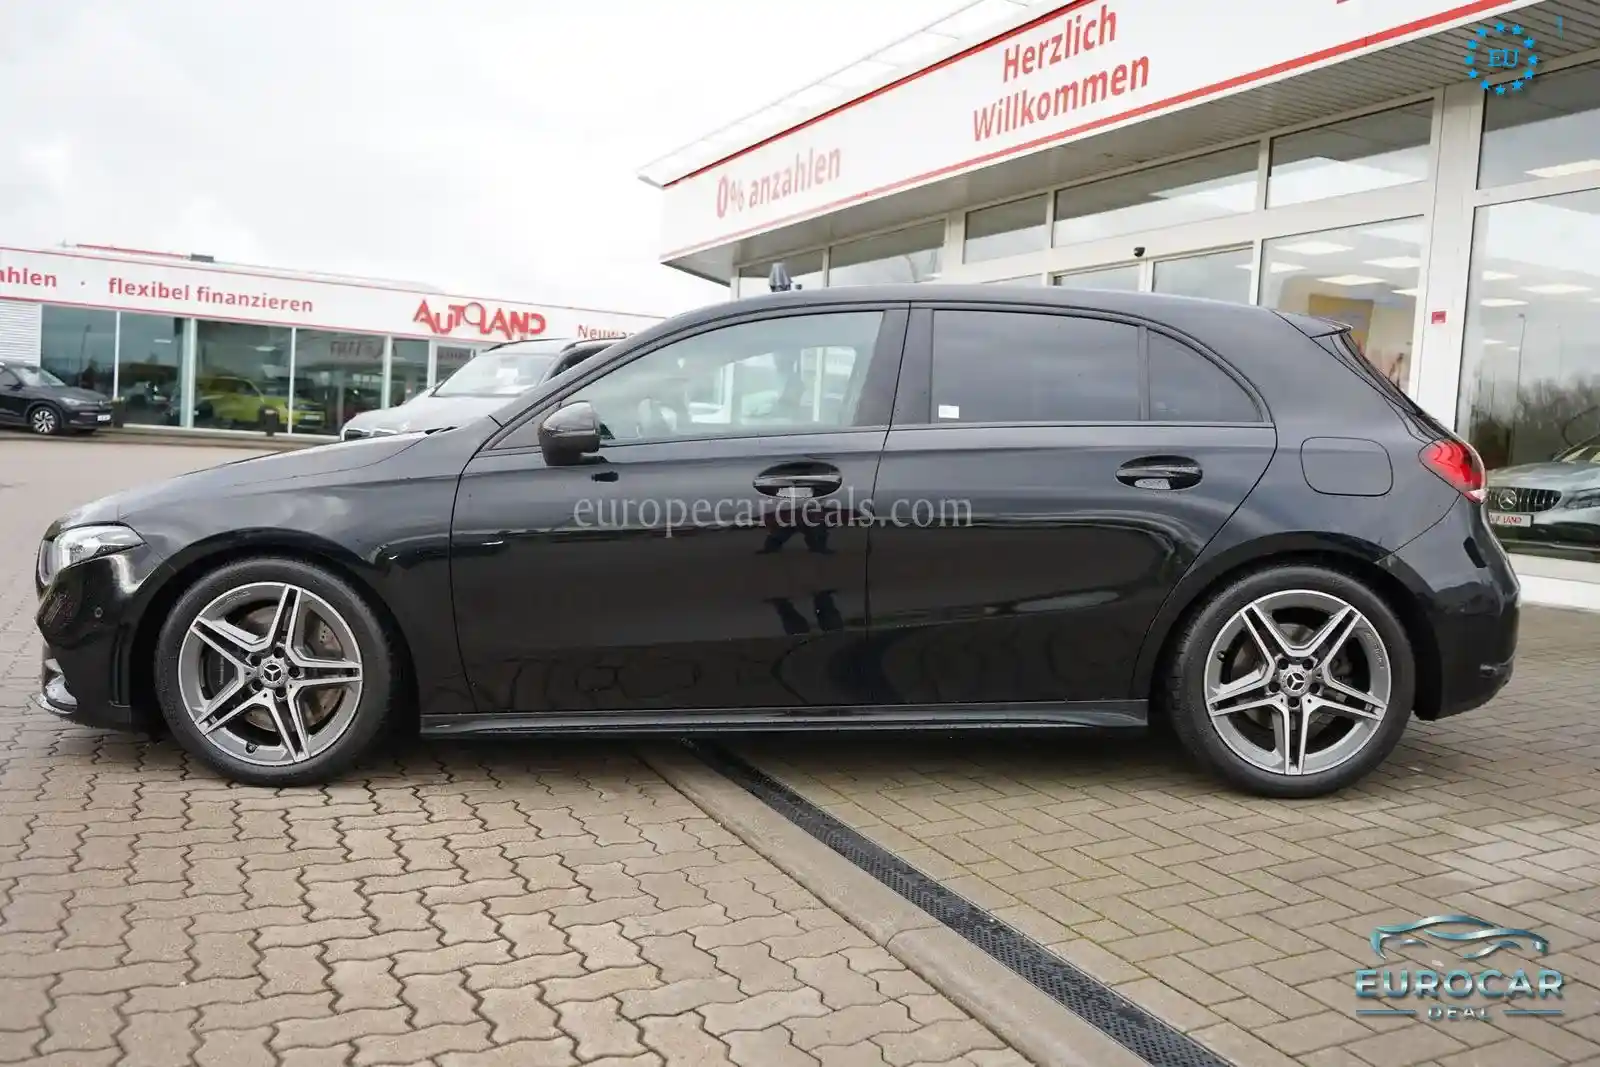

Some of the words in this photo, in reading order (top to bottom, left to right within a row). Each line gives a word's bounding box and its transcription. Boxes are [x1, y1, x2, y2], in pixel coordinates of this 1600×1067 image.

[1003, 6, 1117, 82] Herzlich
[973, 55, 1150, 141] Willkommen
[716, 174, 744, 219] 0%
[749, 147, 841, 208] anzahlen
[109, 277, 190, 301] flexibel
[196, 286, 313, 312] finanzieren
